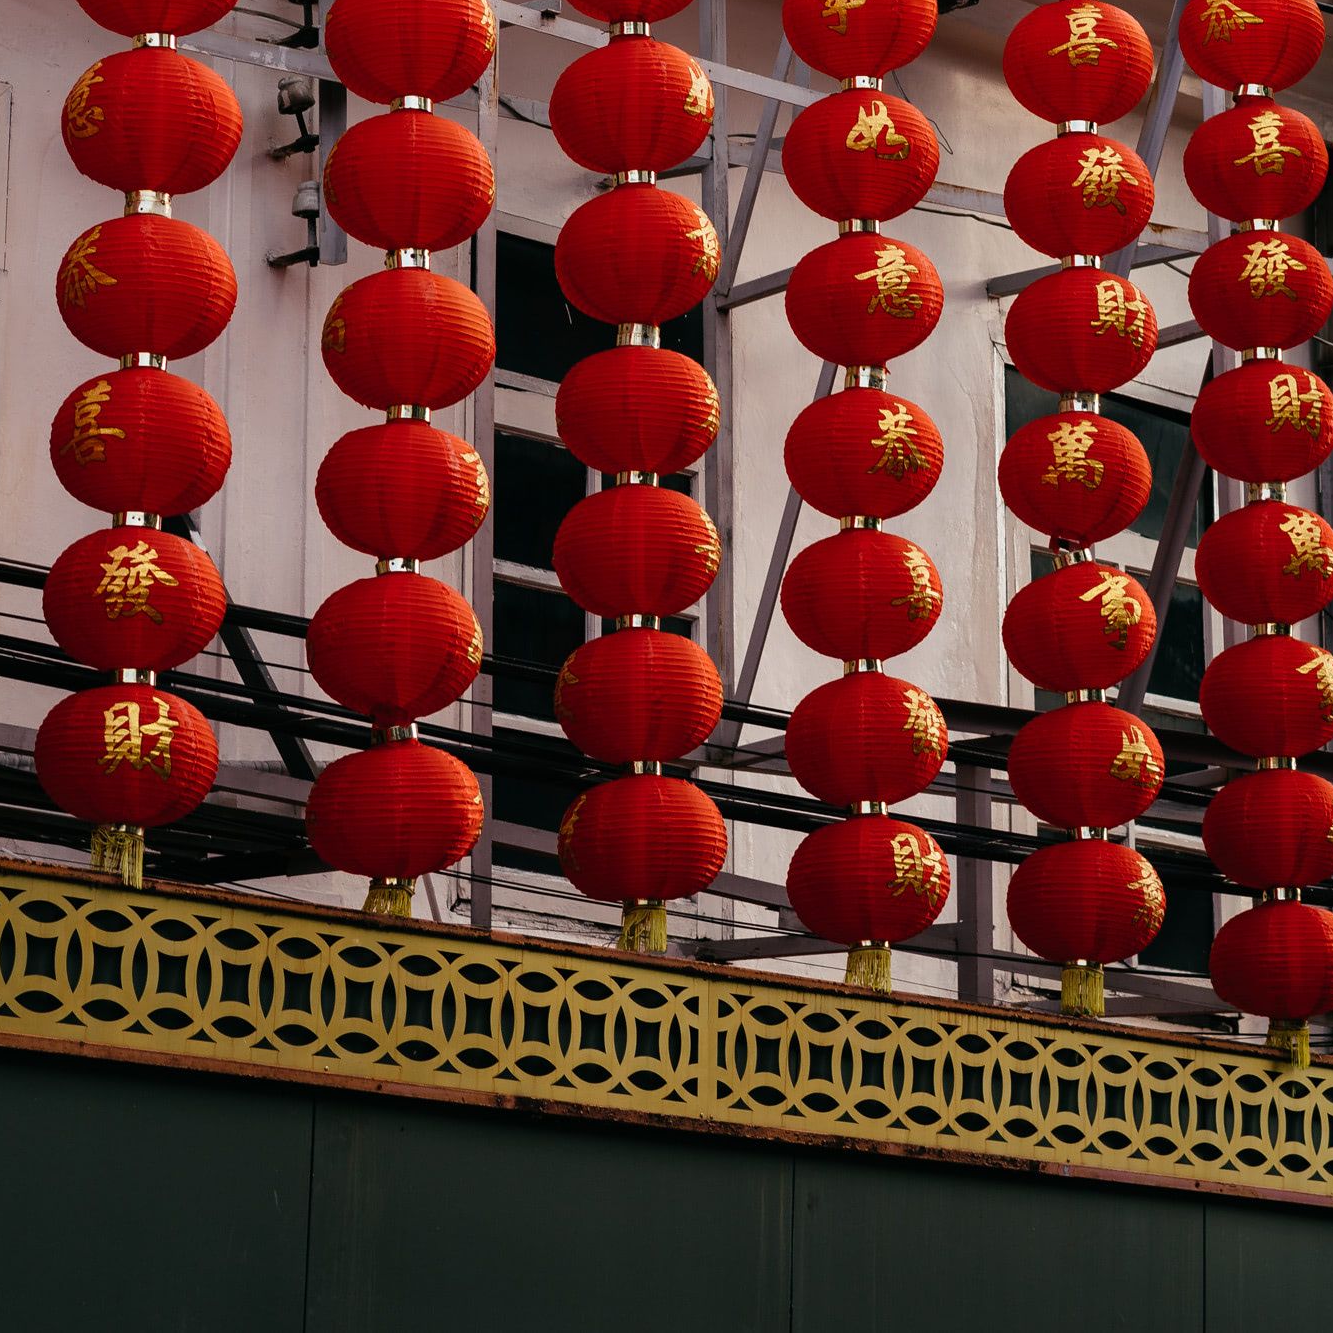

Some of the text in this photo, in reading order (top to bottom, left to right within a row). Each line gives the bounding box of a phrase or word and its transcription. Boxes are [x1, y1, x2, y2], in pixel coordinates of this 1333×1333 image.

[1047, 2, 1119, 68] 喜
[843, 97, 912, 163] 如
[1232, 110, 1303, 177] 喜
[1071, 144, 1140, 216] 發
[58, 224, 119, 311] 恭
[852, 242, 924, 321] 意
[1237, 236, 1309, 302] 發
[1088, 277, 1150, 349] 財
[59, 379, 127, 467] 喜
[865, 400, 933, 482] 恭
[1263, 369, 1327, 440] 財
[1040, 418, 1106, 491] 萬
[93, 538, 180, 626] 發
[889, 542, 943, 624] 喜
[1078, 569, 1144, 652] 事
[96, 695, 180, 782] 財
[901, 687, 946, 760] 發
[1108, 723, 1165, 791] 如
[884, 829, 943, 907] 財
